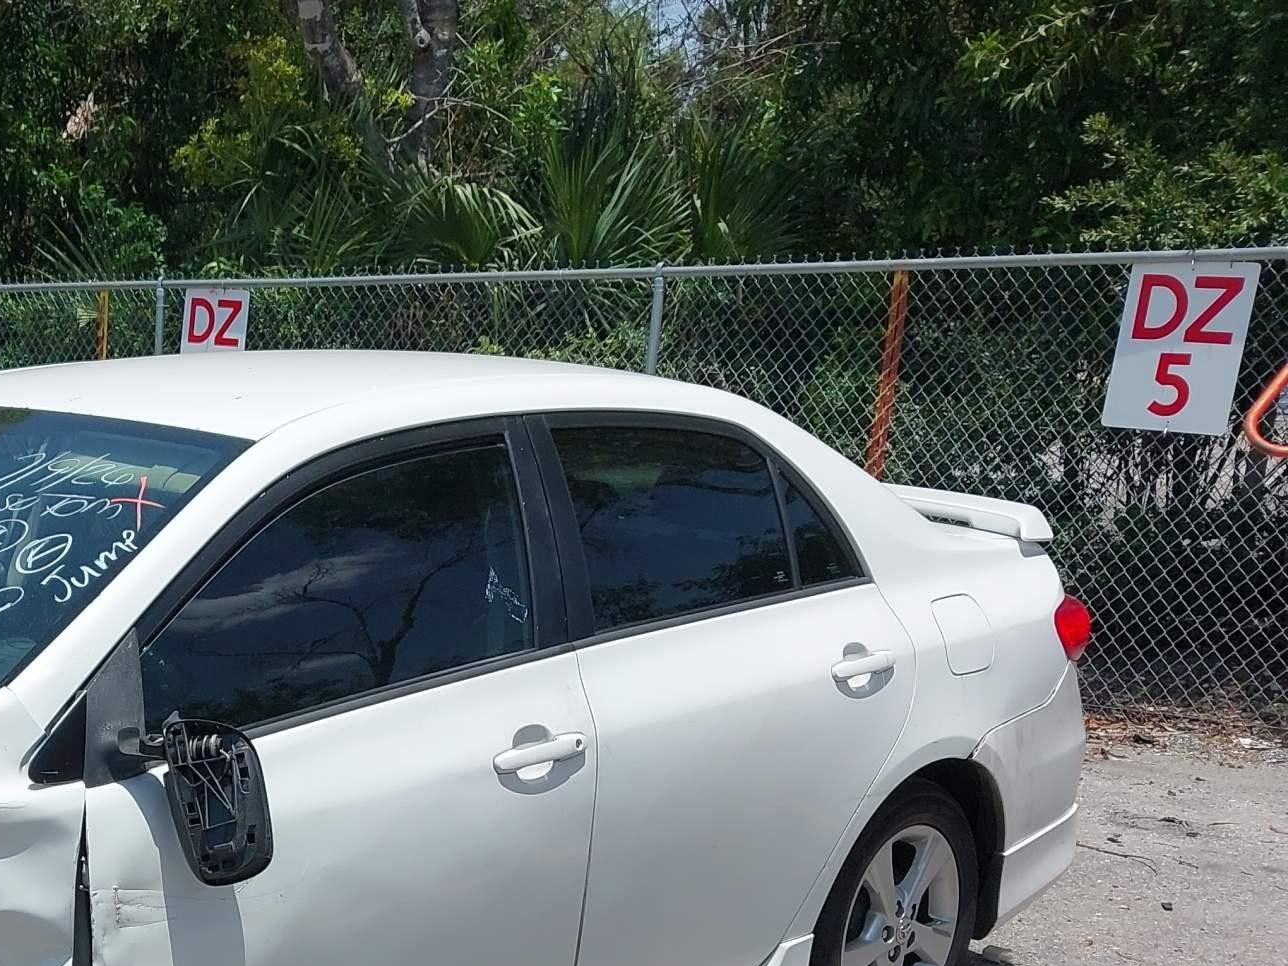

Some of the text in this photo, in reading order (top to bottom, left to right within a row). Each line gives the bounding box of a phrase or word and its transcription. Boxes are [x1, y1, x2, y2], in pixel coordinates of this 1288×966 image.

[187, 297, 243, 347] DZ
[1131, 273, 1246, 345] DZ
[1147, 352, 1193, 417] 5
